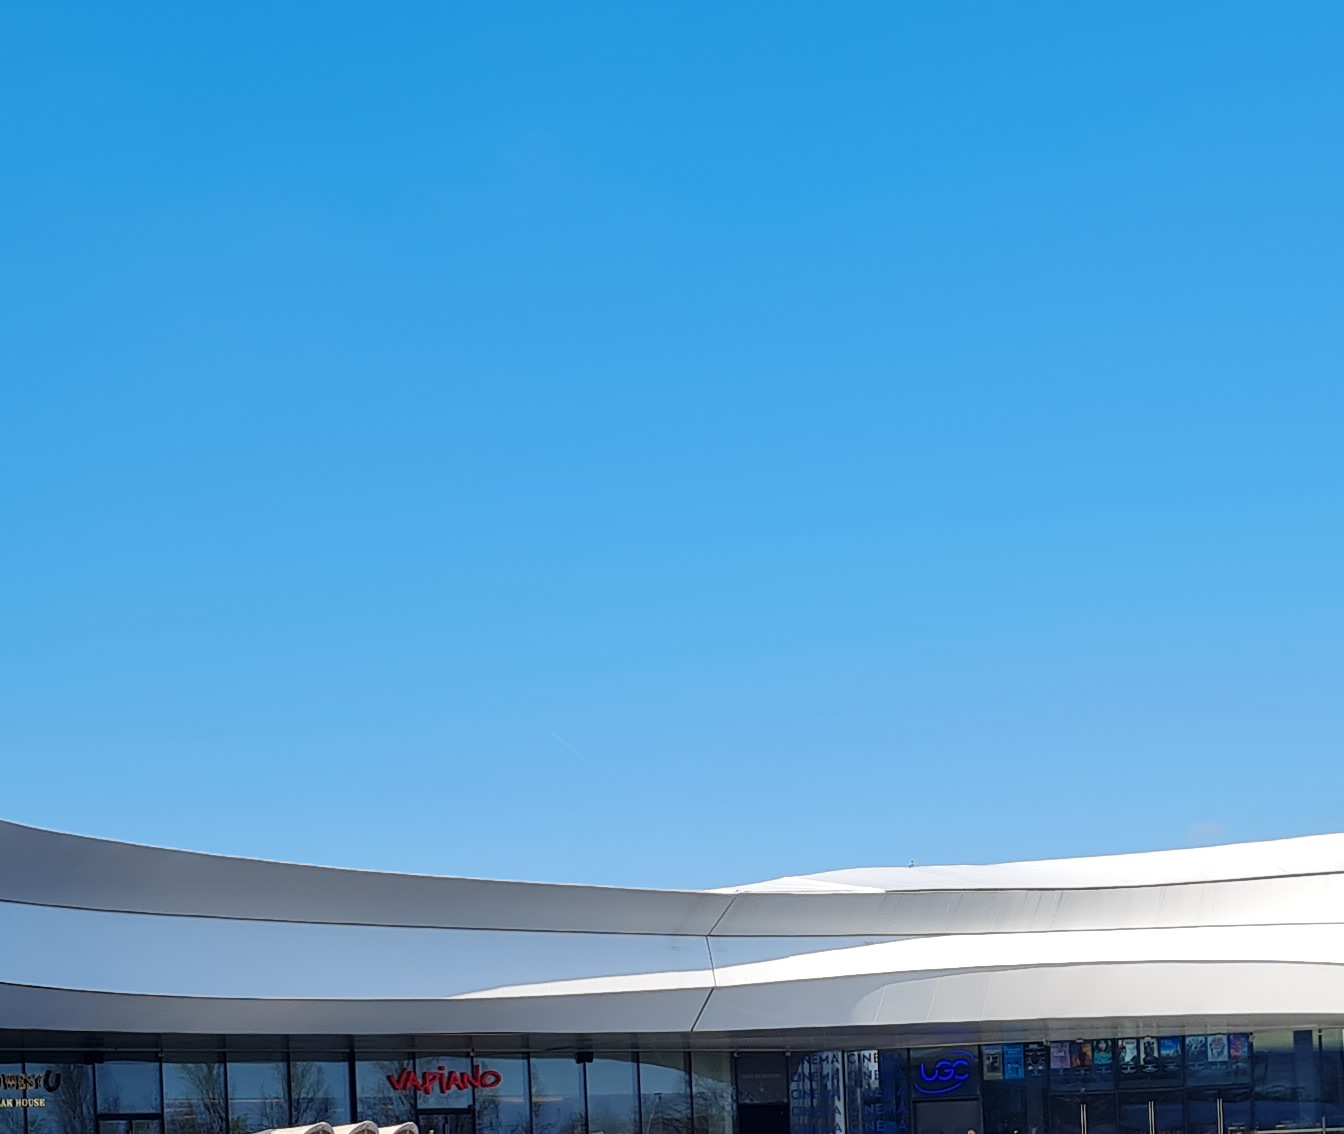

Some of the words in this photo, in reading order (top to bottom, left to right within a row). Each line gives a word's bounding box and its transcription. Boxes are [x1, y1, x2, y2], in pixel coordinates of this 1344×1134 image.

[797, 1054, 840, 1065] NEMA
[919, 1060, 969, 1083] UGC
[15, 1098, 46, 1108] HOUSE
